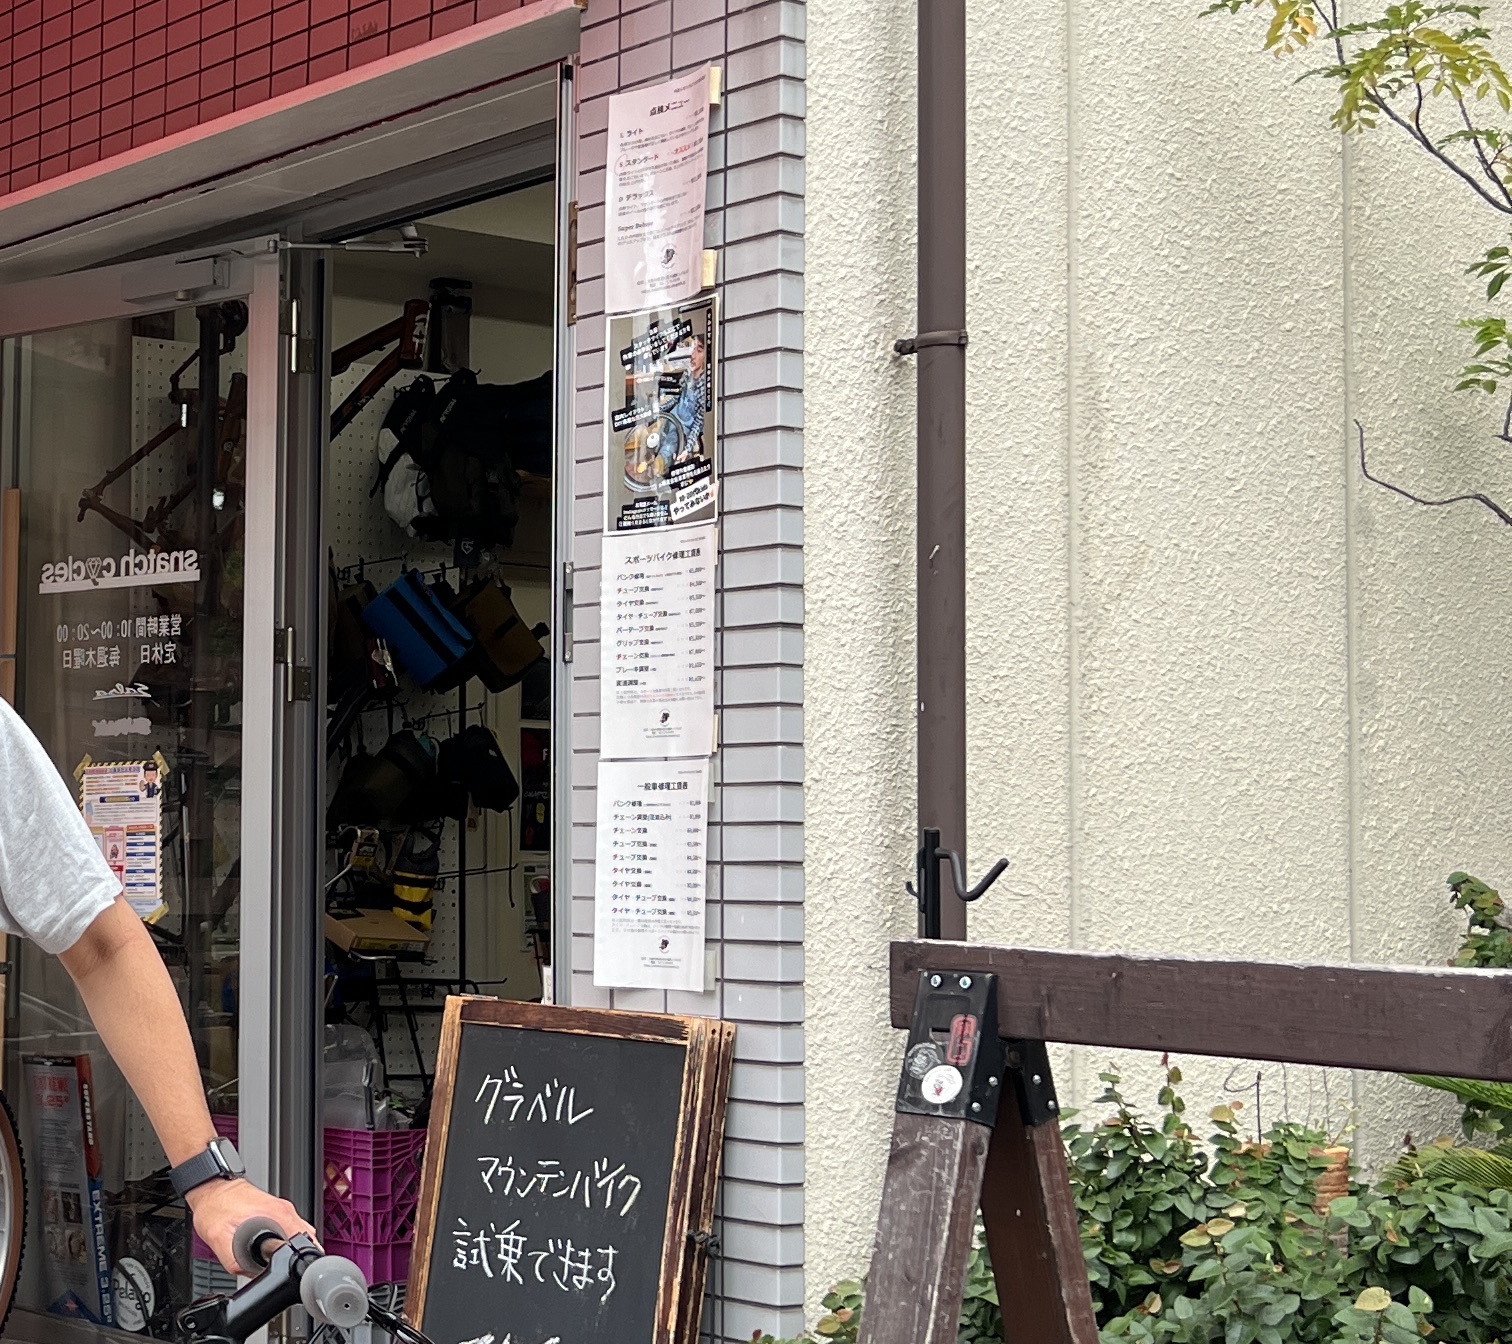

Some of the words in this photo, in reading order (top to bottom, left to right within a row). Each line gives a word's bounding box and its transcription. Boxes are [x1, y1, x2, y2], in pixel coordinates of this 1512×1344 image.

[475, 1066, 594, 1127] グラベル
[477, 1156, 642, 1217] マウンテンバイク
[451, 1218, 619, 1304] 試乗できます
